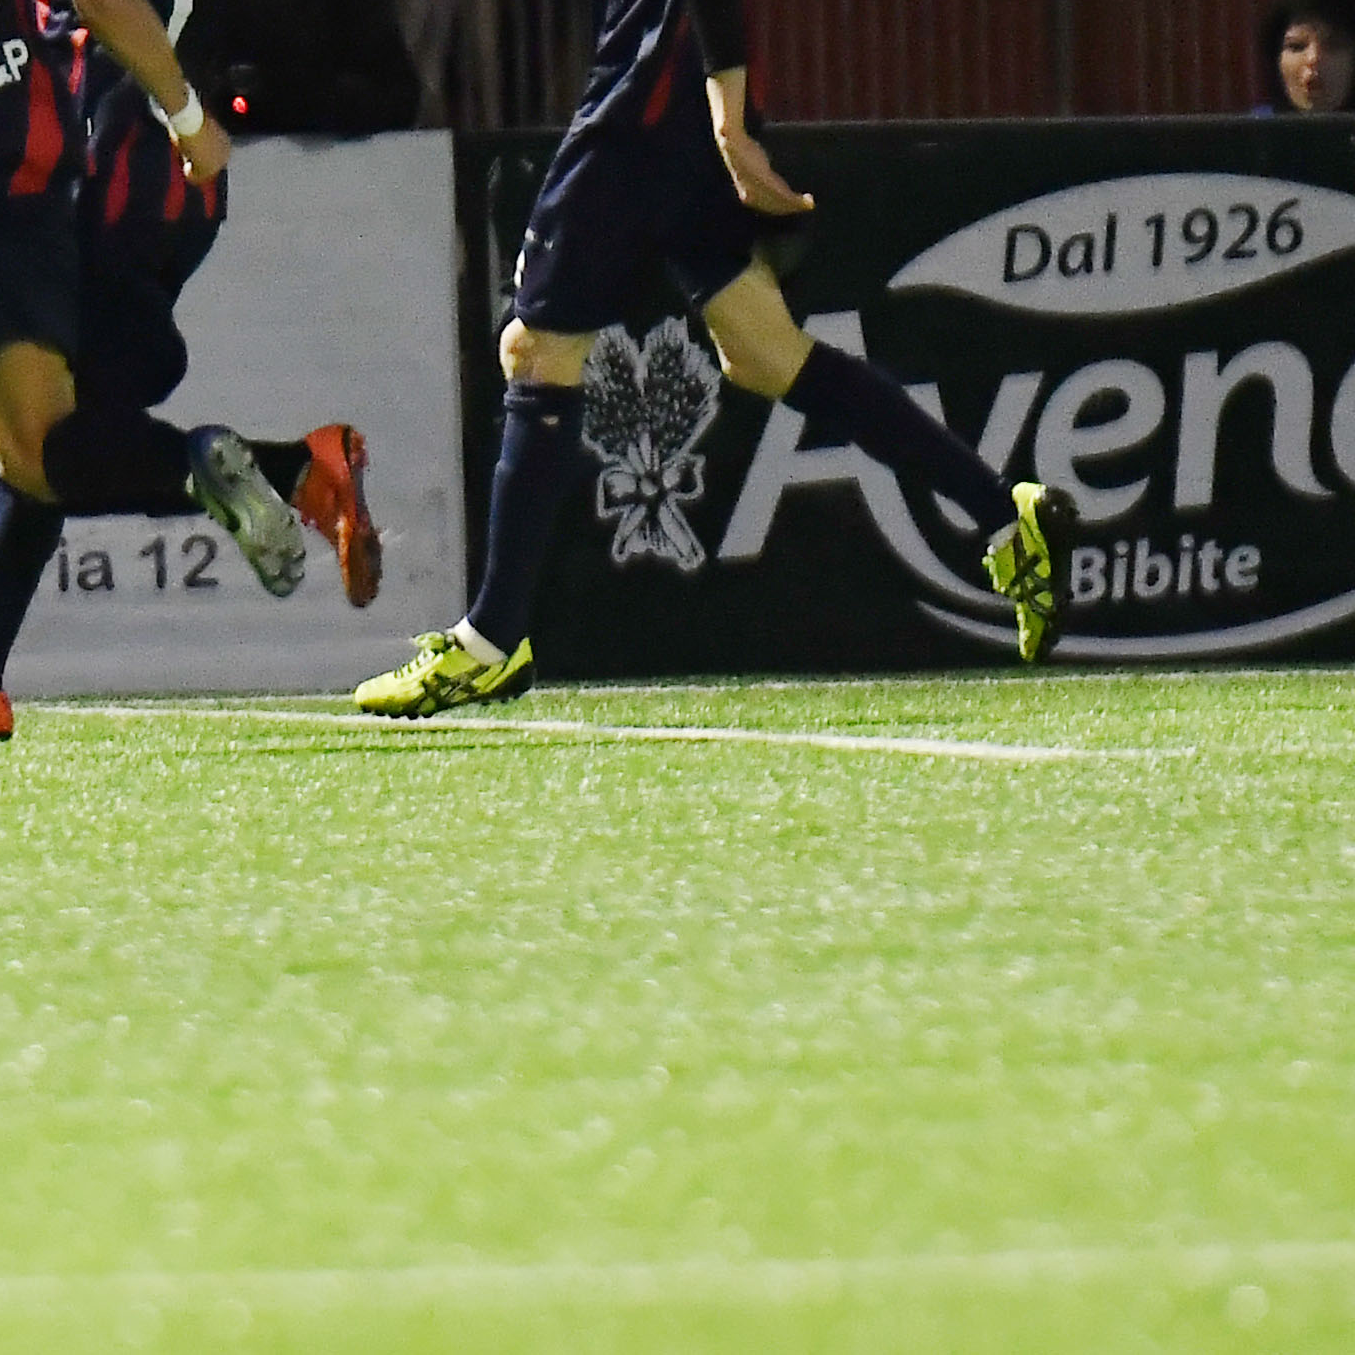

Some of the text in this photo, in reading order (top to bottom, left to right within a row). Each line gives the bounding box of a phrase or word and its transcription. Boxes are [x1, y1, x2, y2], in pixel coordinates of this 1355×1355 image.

[1003, 197, 1304, 283] Dal 1926
[717, 309, 1355, 608] Aven
[139, 535, 220, 590] 12
[1070, 533, 1263, 604] Bibite
